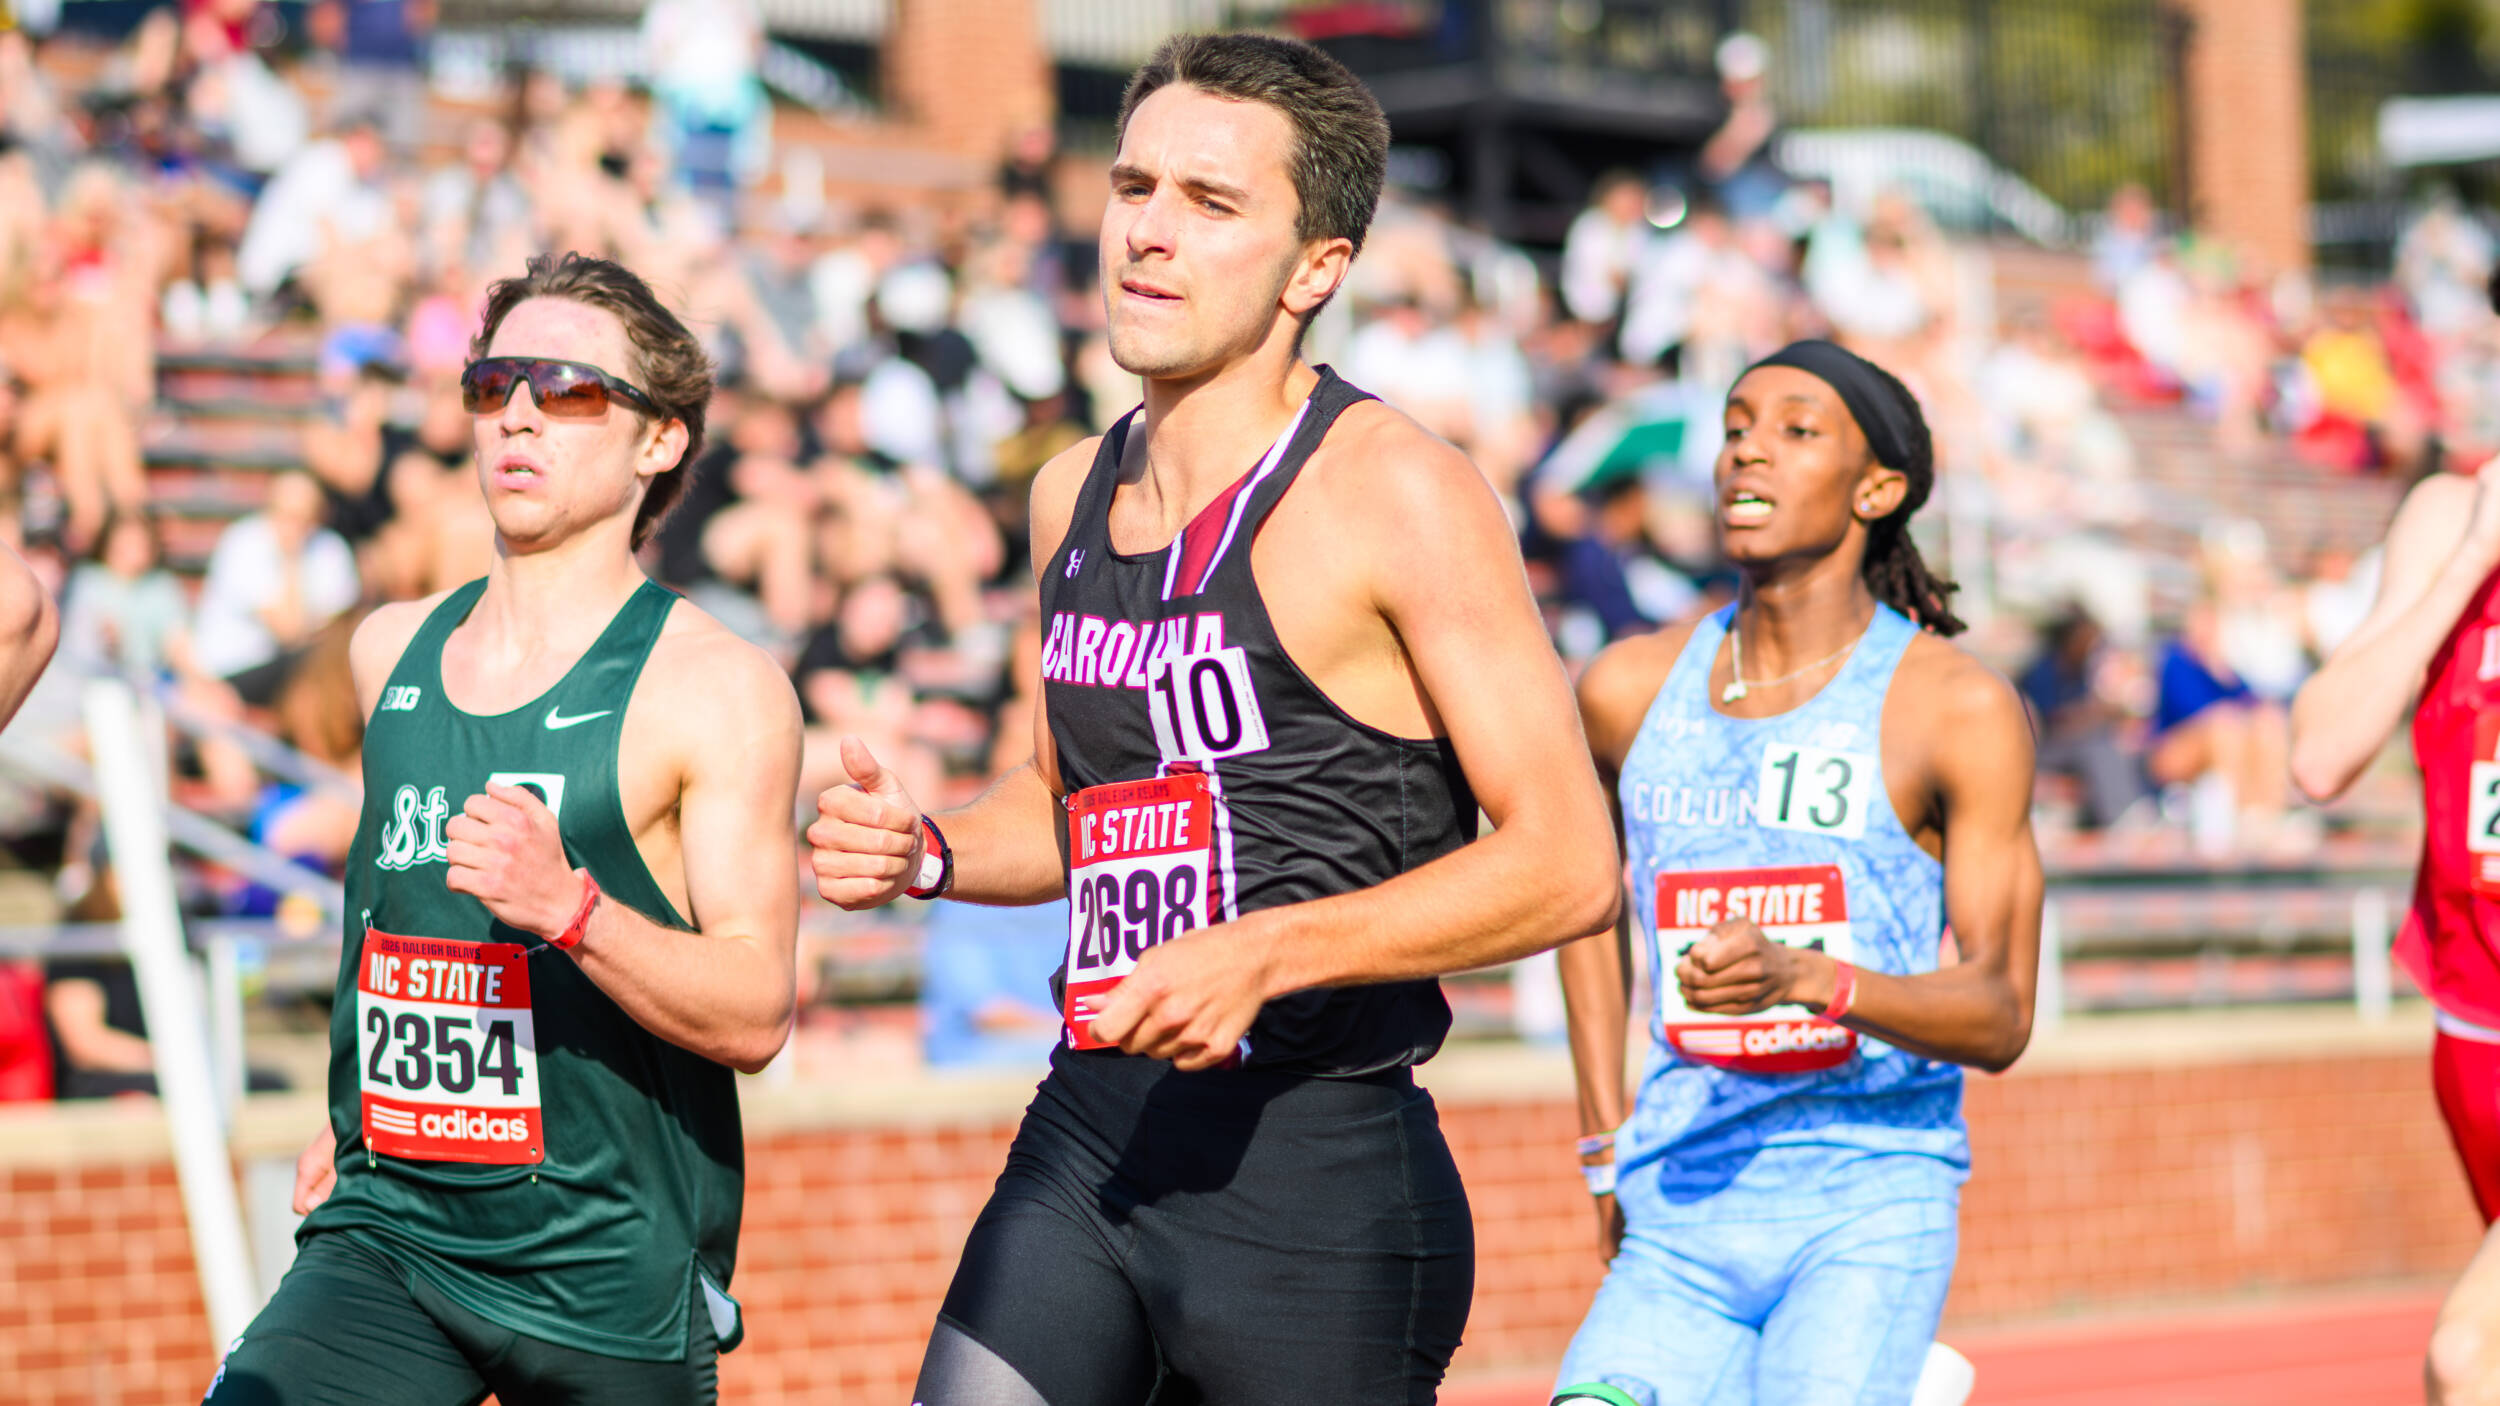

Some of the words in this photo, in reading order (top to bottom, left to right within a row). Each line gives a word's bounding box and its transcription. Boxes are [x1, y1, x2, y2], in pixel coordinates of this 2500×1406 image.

[1154, 658, 1243, 756] 10
[1772, 751, 1853, 829] 13
[1080, 812, 1097, 860] NC
[1101, 800, 1193, 855] STATE
[1076, 864, 1198, 971] 2698
[1675, 887, 1721, 928] NC
[1725, 882, 1825, 925] STATE
[368, 951, 402, 997] NC
[407, 958, 505, 1004] STATE
[402, 941, 444, 957] RALEIGH
[445, 944, 482, 960] RELAYS
[366, 1005, 524, 1097] 2354
[1743, 1022, 1850, 1056] adidas
[420, 1109, 529, 1142] adidas
